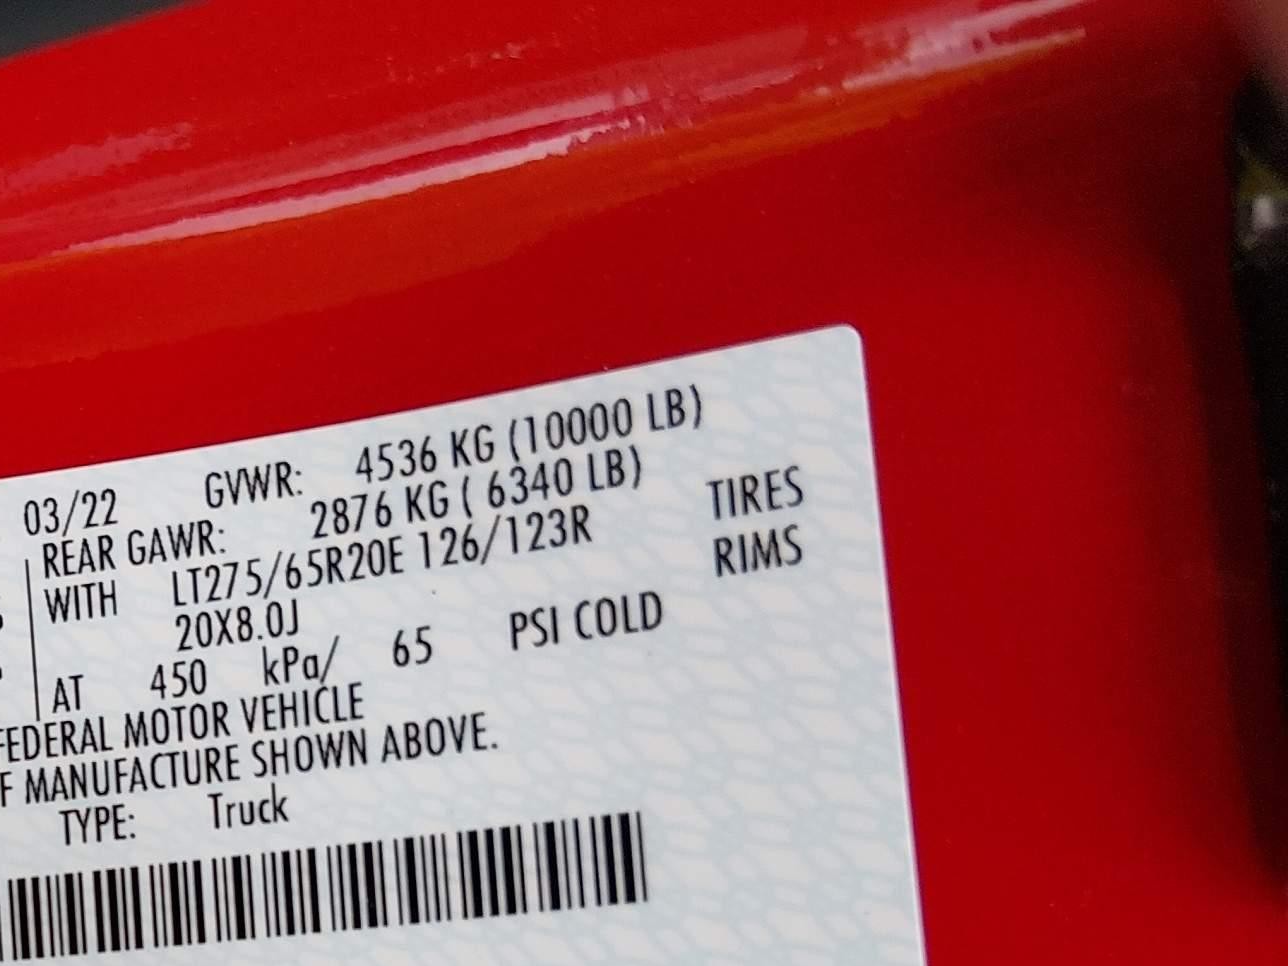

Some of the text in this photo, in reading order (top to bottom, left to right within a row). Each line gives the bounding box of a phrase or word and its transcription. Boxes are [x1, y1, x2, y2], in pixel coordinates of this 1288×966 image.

[204, 383, 702, 509] GVWR: 4536 KG (10000 LB)
[23, 487, 118, 538] 03/22
[42, 534, 117, 580] REAR
[127, 519, 226, 566] GAWR:
[310, 490, 393, 540] 2876
[405, 479, 449, 524] KG
[587, 444, 642, 492] LB)
[43, 465, 804, 625] WITH LT275/65R20E 126/123R TIRES
[175, 523, 803, 652] 20X8.0J RIMS
[52, 590, 663, 714] AT 450 kPa/ 65 PSI COLD
[25, 743, 241, 805] MANUFACTURE
[251, 727, 368, 778] SHOWN
[381, 711, 498, 763] ABOVE.
[124, 700, 231, 749] MOTOR
[239, 681, 364, 734] VEHICLE
[58, 803, 136, 846] TYPE:
[207, 782, 289, 830] Truck
